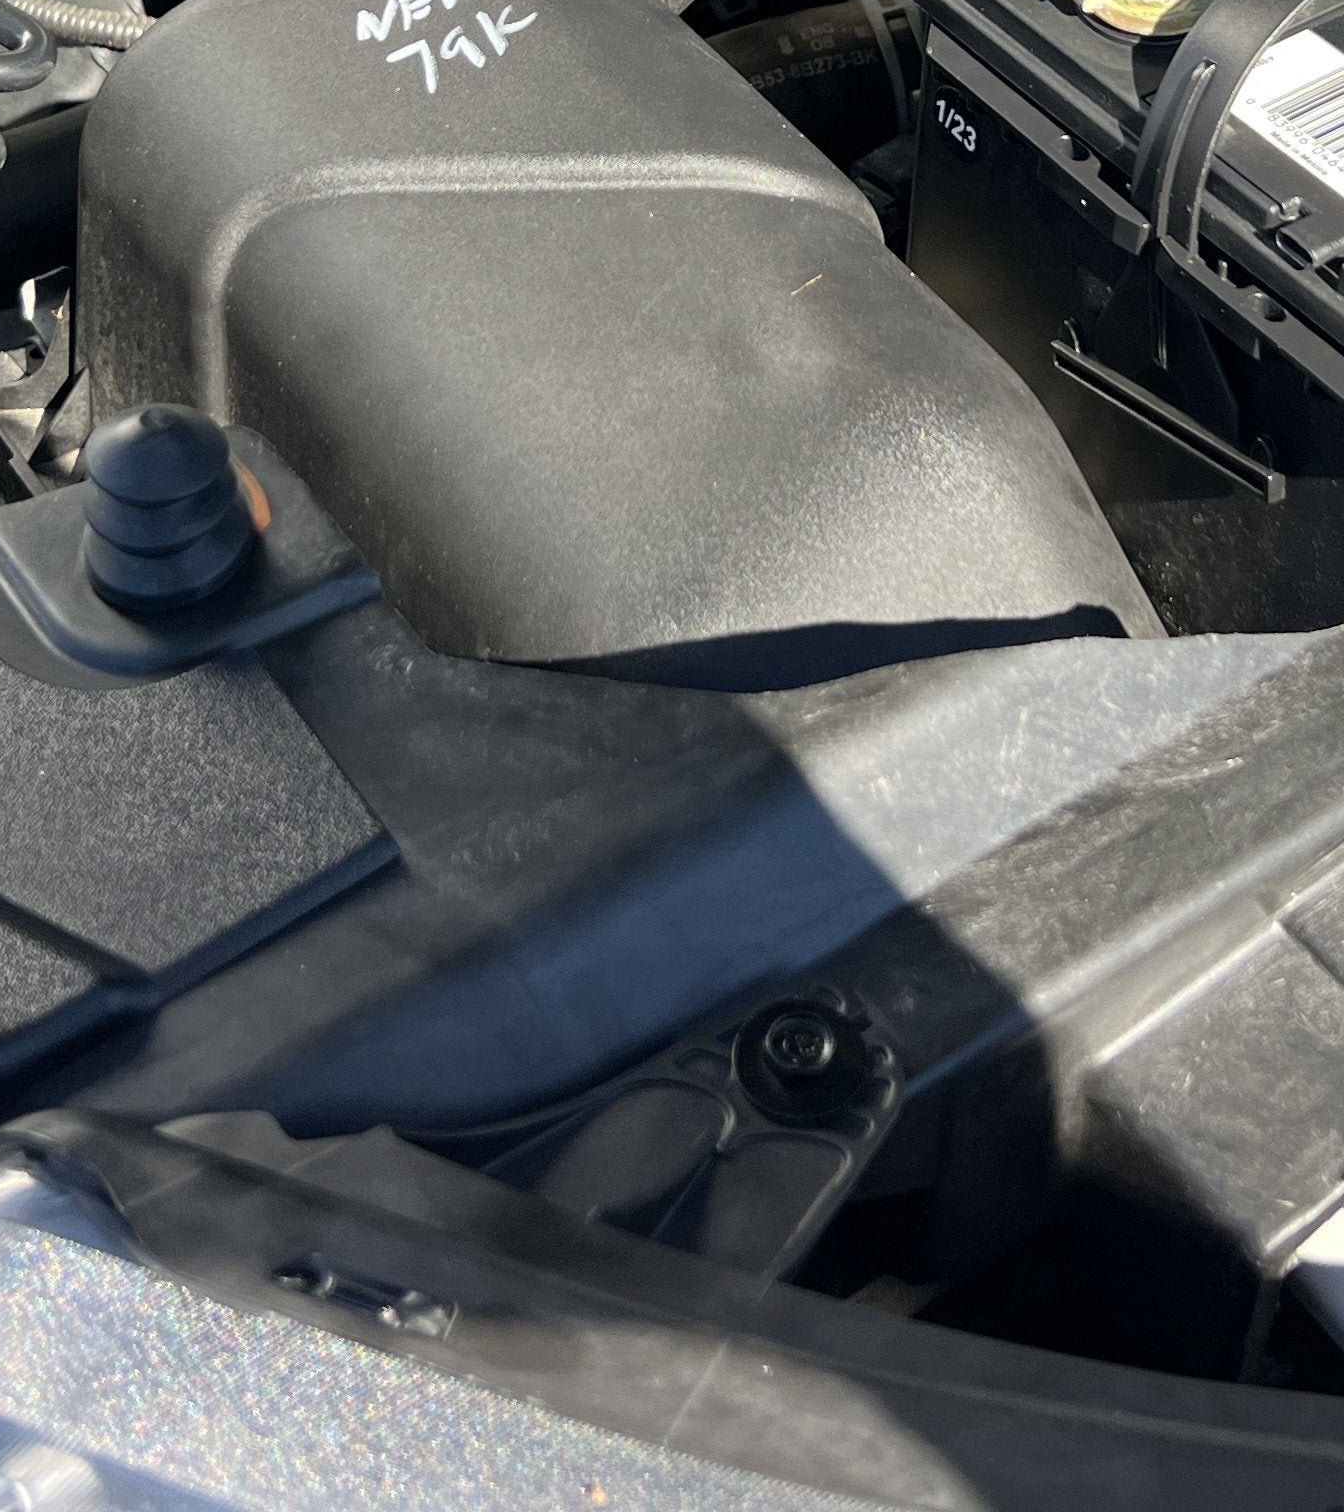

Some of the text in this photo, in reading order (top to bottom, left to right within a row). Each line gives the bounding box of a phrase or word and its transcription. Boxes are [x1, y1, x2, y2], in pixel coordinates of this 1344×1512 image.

[386, 4, 538, 94] 79K
[1244, 96, 1256, 105] 0
[936, 99, 977, 152] 1/23
[1267, 130, 1293, 148] Made
[1298, 153, 1330, 175] Mexico
